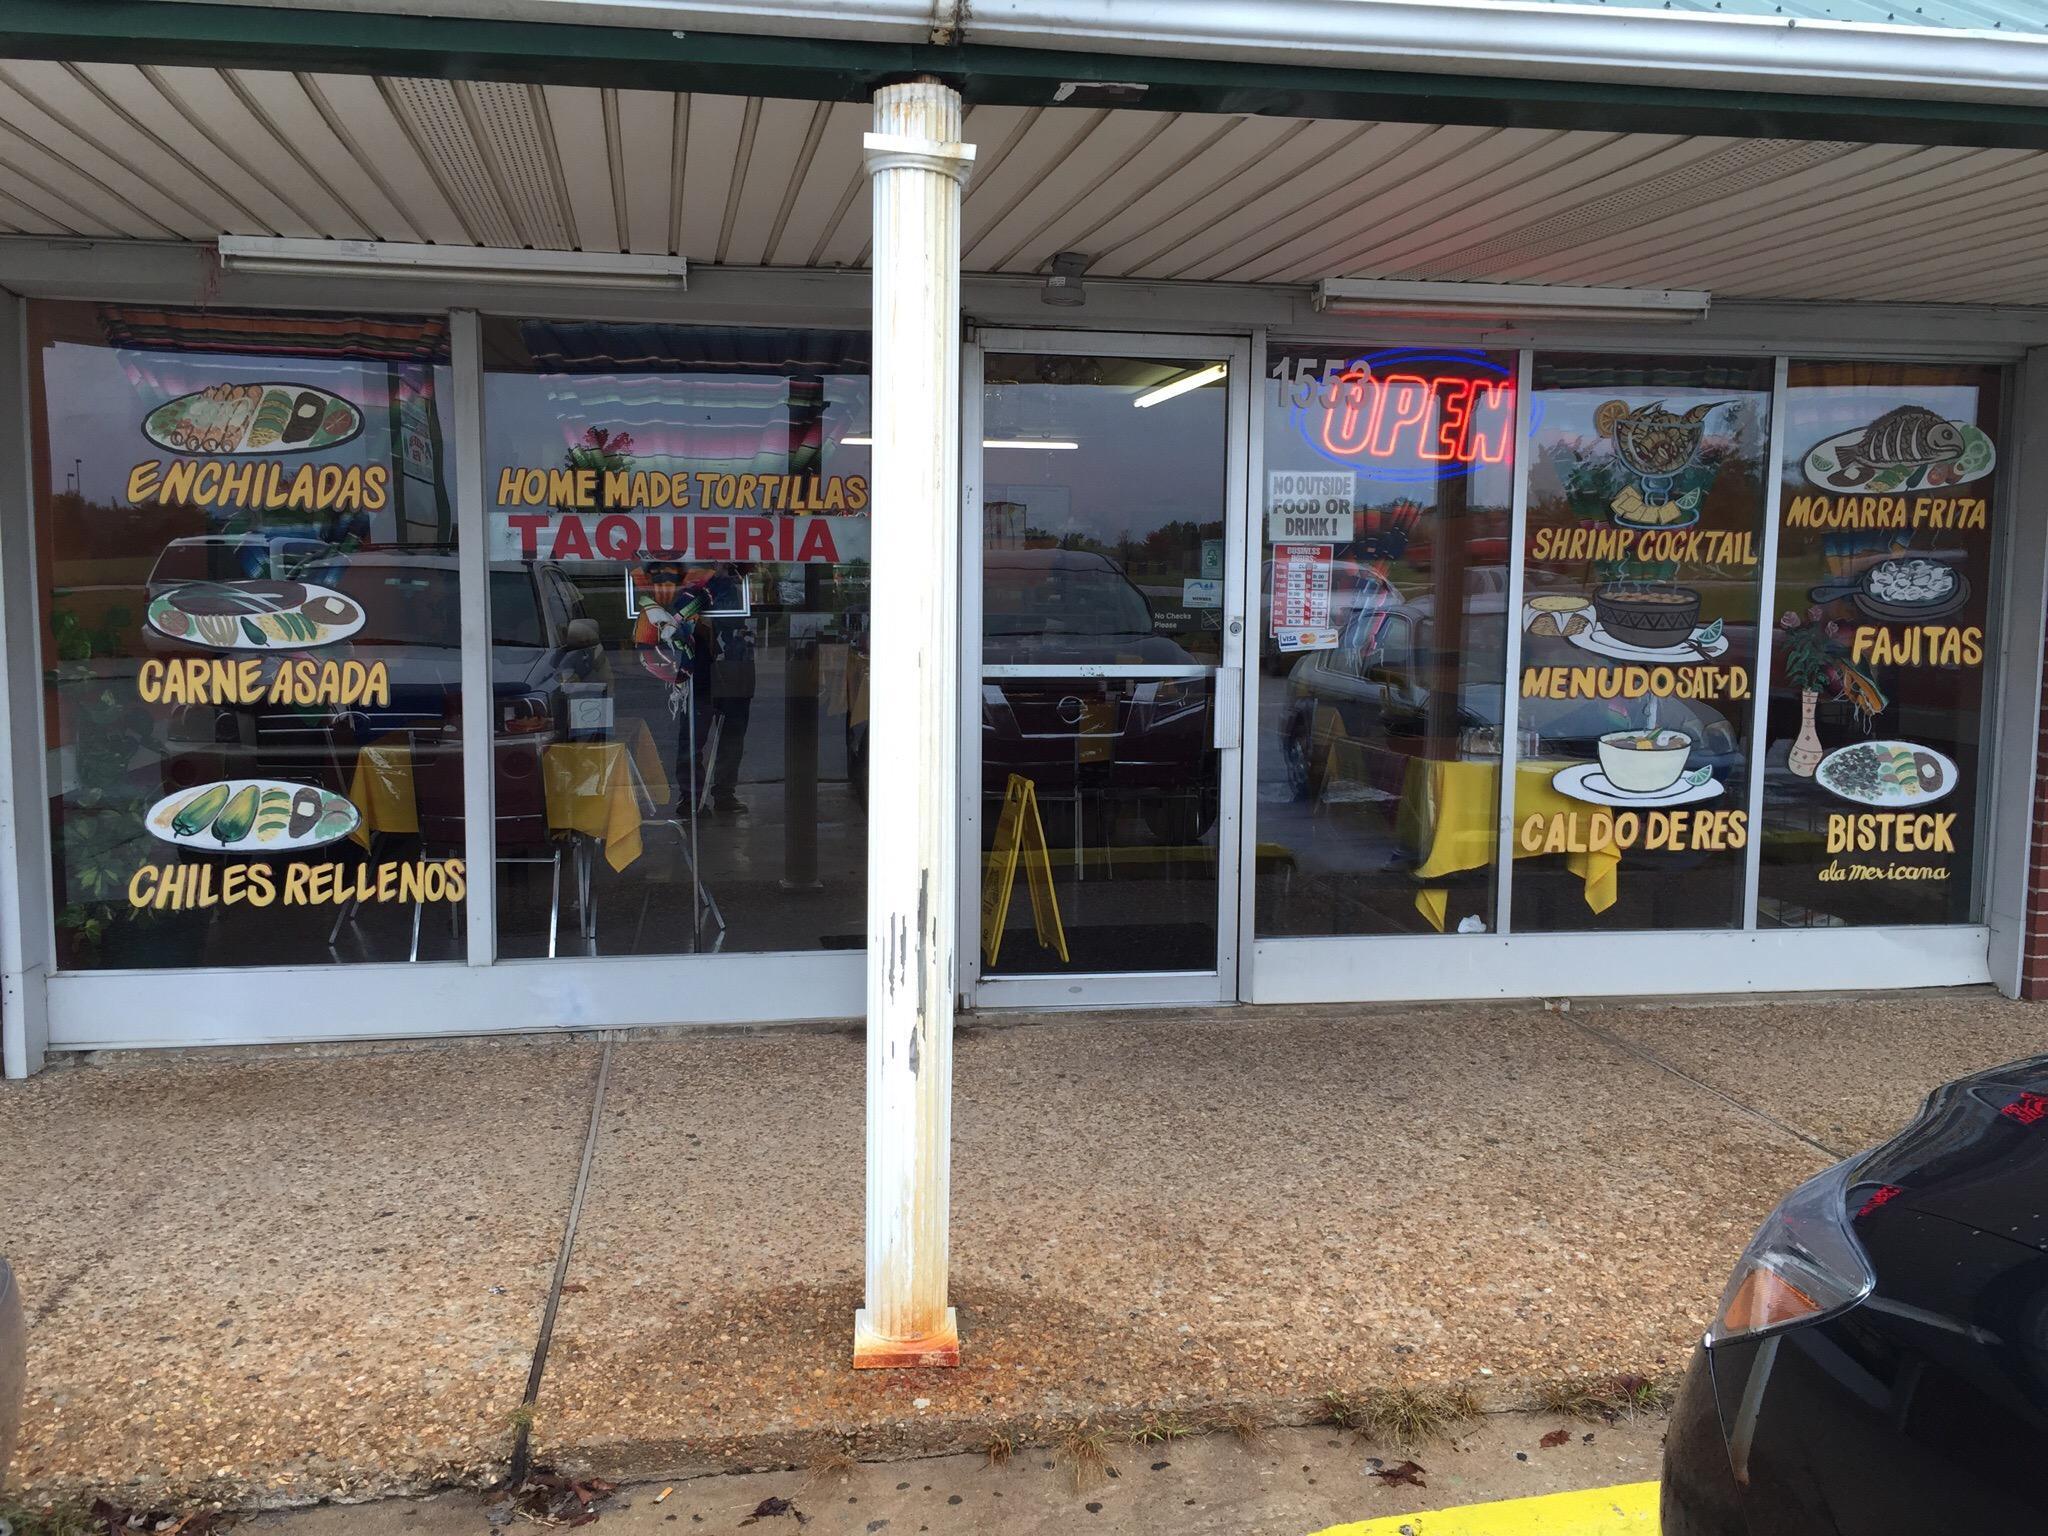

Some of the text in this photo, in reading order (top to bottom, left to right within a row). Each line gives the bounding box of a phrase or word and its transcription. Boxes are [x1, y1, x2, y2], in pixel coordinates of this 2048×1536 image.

[1322, 372, 1513, 463] OPEN
[128, 460, 389, 512] ENCHILADAS
[498, 467, 868, 511] HOME MADE TORTILLAS
[1273, 476, 1351, 496] NO OUTSIDE
[1273, 499, 1351, 515] FOOD OR
[1786, 496, 1986, 529] MOJARRA FRITA
[508, 514, 841, 562] TAQUERIA
[1532, 528, 1758, 565] SHRIMP COCKTAIL
[1154, 611, 1192, 620] No Checks
[1154, 621, 1177, 629] Please
[1852, 625, 1984, 667] FAJITAS
[138, 658, 390, 707] CARNE ASADA
[1522, 665, 1675, 700] MENUDO
[1521, 809, 1748, 854] CALDO DE RES
[1827, 813, 1957, 853] BISTECK
[128, 858, 466, 910] CHILES RELLENOS
